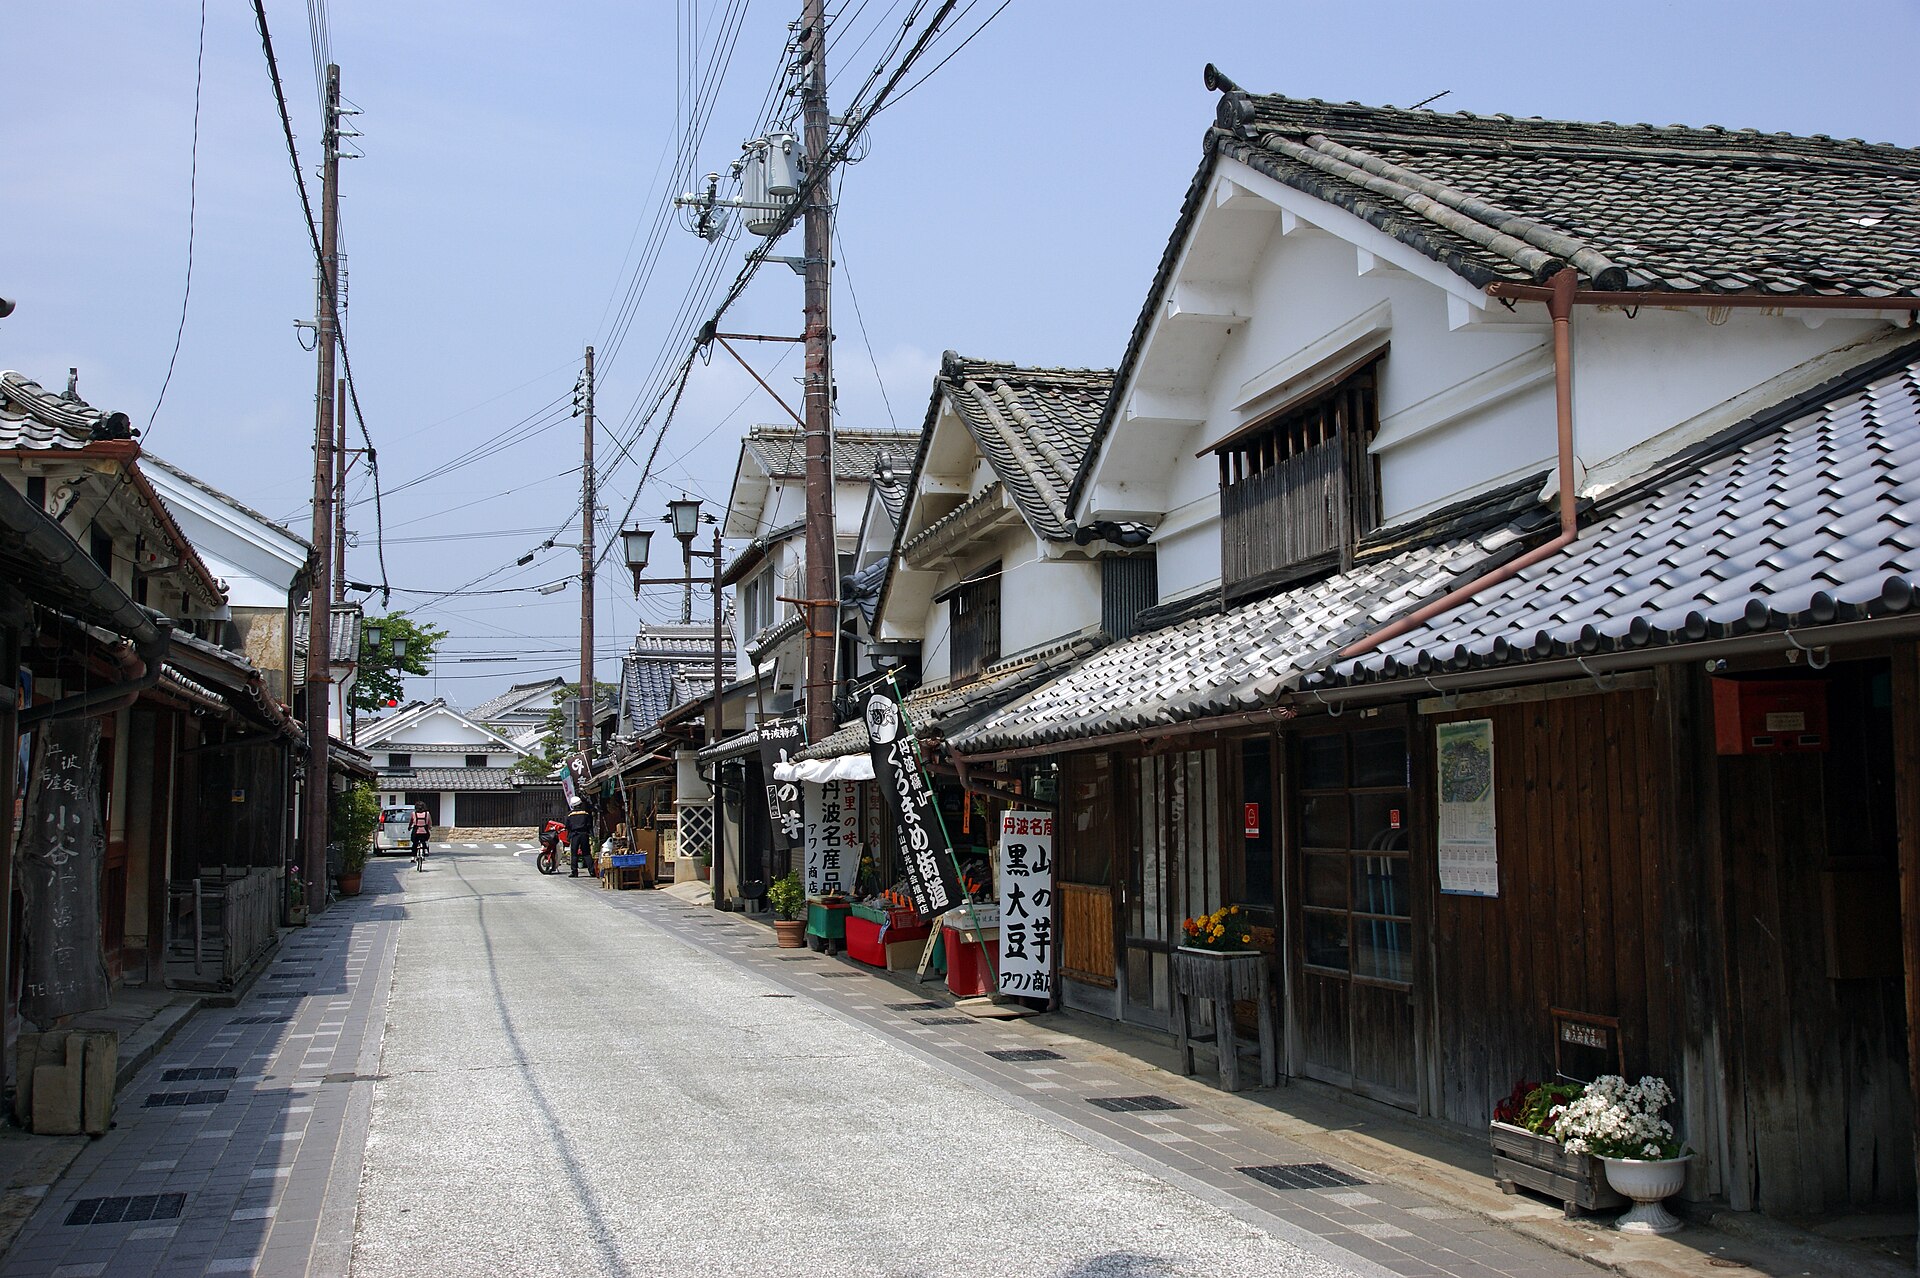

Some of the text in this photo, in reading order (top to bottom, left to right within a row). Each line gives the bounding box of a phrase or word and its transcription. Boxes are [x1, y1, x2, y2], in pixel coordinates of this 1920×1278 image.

[760, 725, 799, 740] 丹波特産
[897, 738, 928, 807] 丹波篠山
[807, 823, 819, 894] アワノ商店
[821, 780, 842, 895] 丹波名産品
[887, 743, 950, 910] くろまめ街道
[1004, 843, 1030, 961] 黒大豆
[1030, 844, 1052, 964] 山の芋
